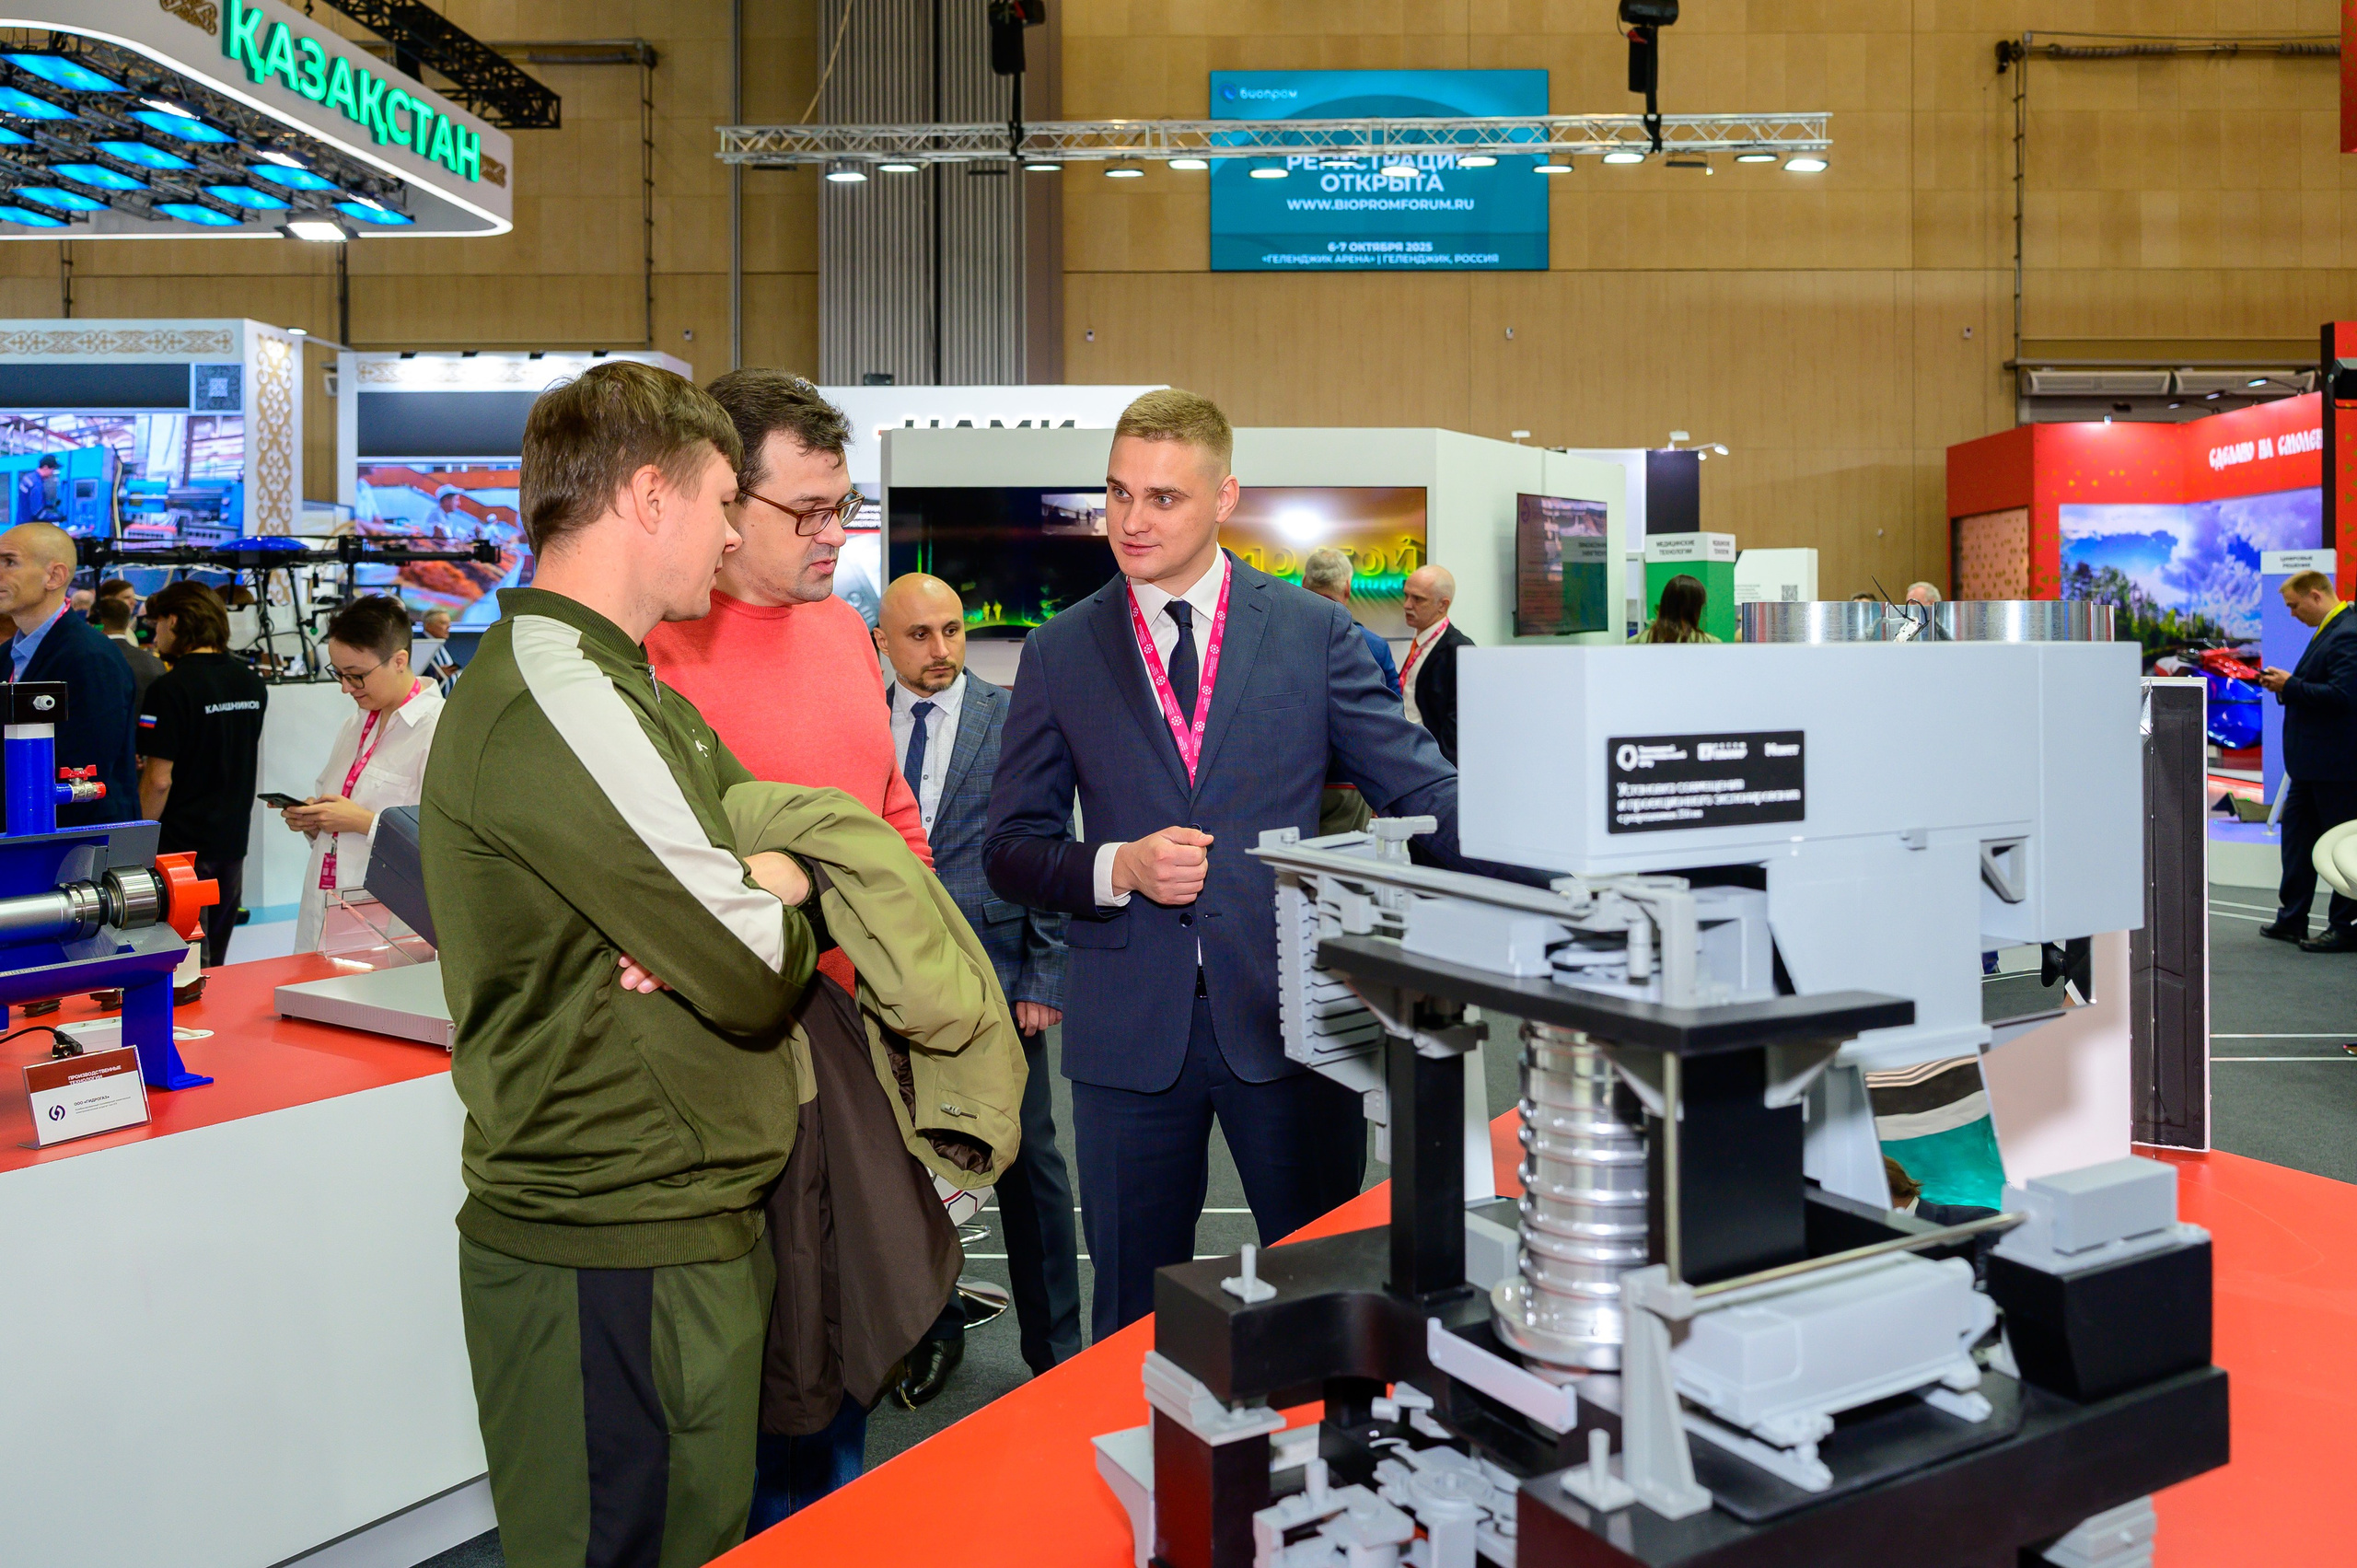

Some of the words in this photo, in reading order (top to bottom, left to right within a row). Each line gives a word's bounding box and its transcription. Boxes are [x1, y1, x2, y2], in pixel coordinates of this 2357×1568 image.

[226, 0, 481, 182] ҚАЗАҚСТАН
[1320, 173, 1446, 192] ОТКРЫТА
[1286, 198, 1475, 211] WWW.BIOPROMFORUM.RU
[1327, 241, 1347, 252] 6-7
[1348, 241, 1403, 252] ОКТЯБРЯ
[1405, 241, 1434, 252] 2025
[1454, 253, 1500, 264] РОССИЯ
[67, 1064, 122, 1081] ПРОИЗВОДСТВЕННЫЕ
